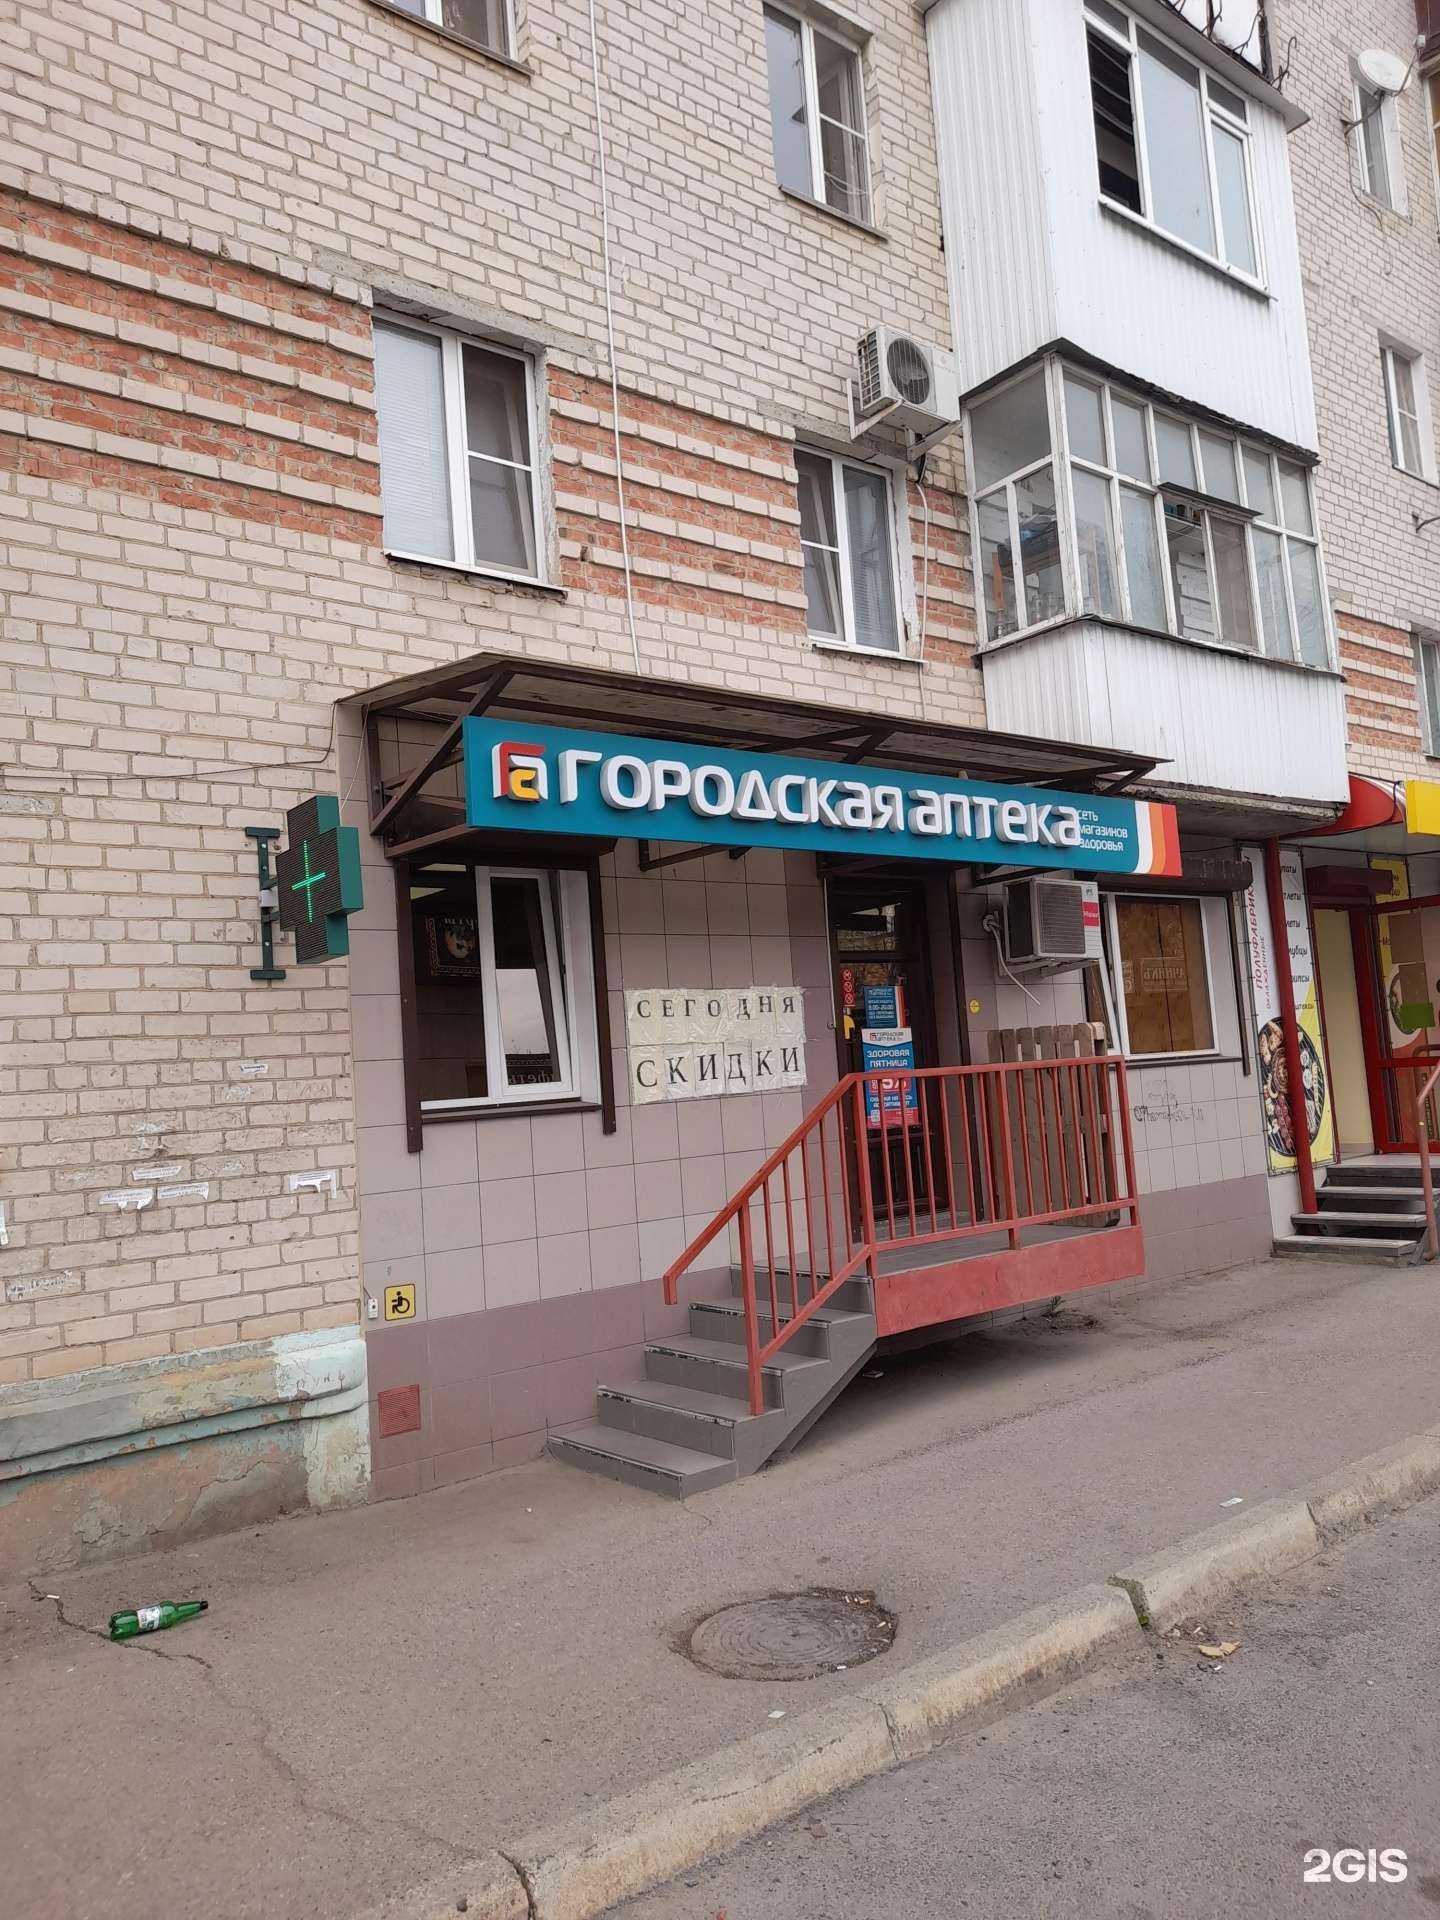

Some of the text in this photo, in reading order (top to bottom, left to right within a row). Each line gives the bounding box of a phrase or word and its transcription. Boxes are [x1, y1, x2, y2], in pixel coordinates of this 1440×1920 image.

[1079, 838, 1124, 852] здоровья
[636, 995, 795, 1021] СЕГОДНЯ
[866, 1049, 910, 1058] ЗДОРОВАЯ
[636, 1047, 800, 1088] СКИДКИ
[870, 1059, 908, 1068] ПЯТНИЦА
